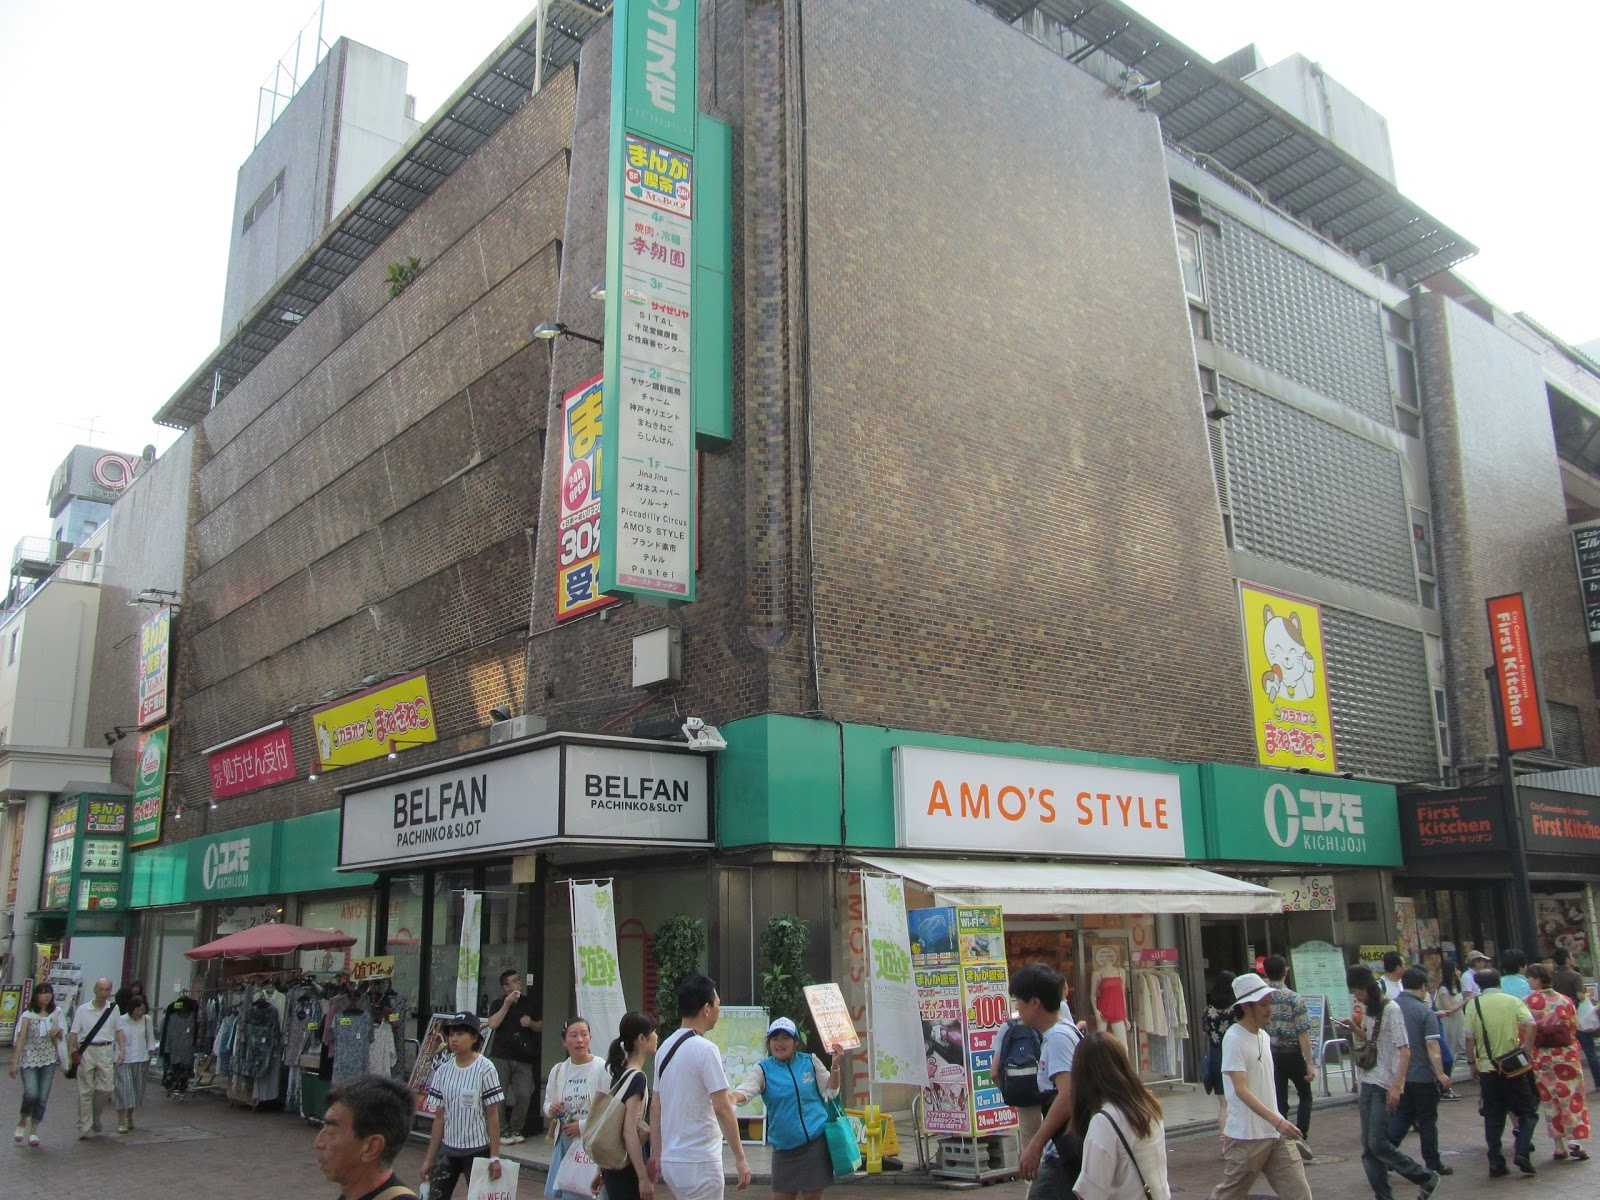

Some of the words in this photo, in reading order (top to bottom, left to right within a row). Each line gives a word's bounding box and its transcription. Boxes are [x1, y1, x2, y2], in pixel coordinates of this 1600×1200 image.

[628, 143, 688, 180] まんが
[628, 237, 685, 268] 李朝園
[651, 301, 688, 319] サイゼリヤ
[637, 418, 673, 433] まねきねこ
[569, 479, 587, 503] OPEN
[629, 481, 681, 497] メガネスーパー
[623, 522, 653, 535] AMO'S
[656, 527, 685, 541] STYLE
[1497, 611, 1513, 654] First
[1503, 656, 1524, 727] Kitchen
[374, 697, 430, 743] まねきねこ
[1264, 722, 1327, 761] まねきねこ
[223, 738, 288, 785] 処方せん受付
[393, 774, 487, 830] BELFAN
[585, 774, 689, 802] BELFAN
[927, 779, 1055, 824] AMO'S
[1077, 791, 1169, 830] STYLE
[1301, 789, 1364, 835] コスモ
[1417, 806, 1459, 821] First
[1532, 814, 1562, 838] First
[1564, 816, 1600, 840] Kitche
[219, 838, 250, 875] コスモ
[1303, 834, 1367, 855] KICHIJOJI
